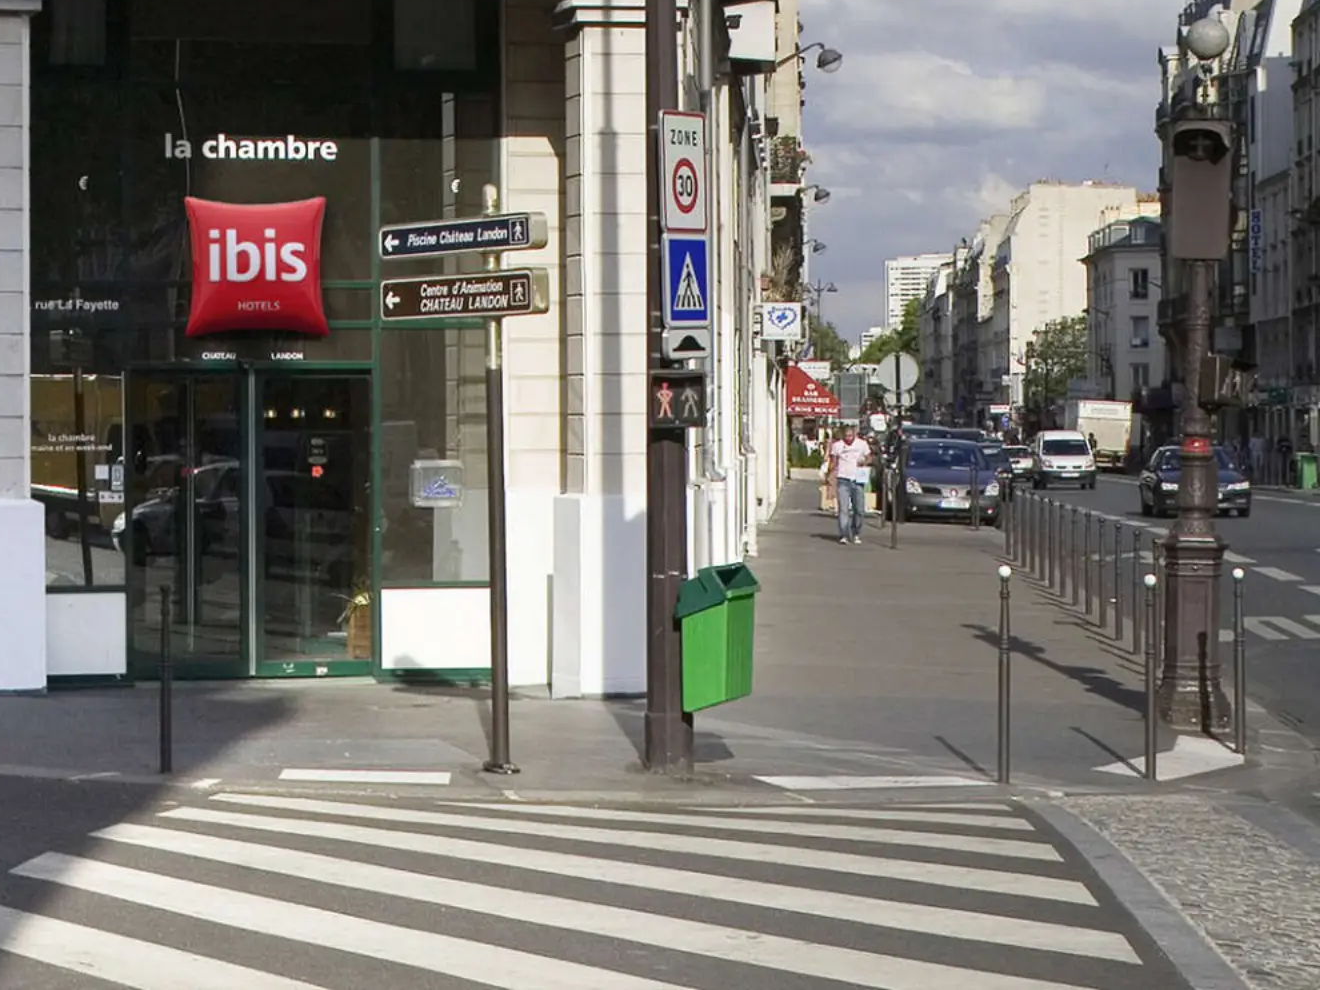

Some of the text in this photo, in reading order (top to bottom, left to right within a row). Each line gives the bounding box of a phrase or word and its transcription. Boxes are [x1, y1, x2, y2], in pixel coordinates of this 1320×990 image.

[165, 133, 338, 159] la chambre
[670, 129, 697, 146] ZONE
[678, 175, 693, 196] 30
[407, 223, 508, 247] Piscine Château Landon
[208, 228, 308, 282] ibis
[420, 279, 504, 297] Centre d'Animation
[75, 299, 120, 313] Fayette
[238, 301, 280, 311] HOTELS
[420, 294, 509, 312] CHATEAU LANDON
[58, 433, 96, 442] chambre
